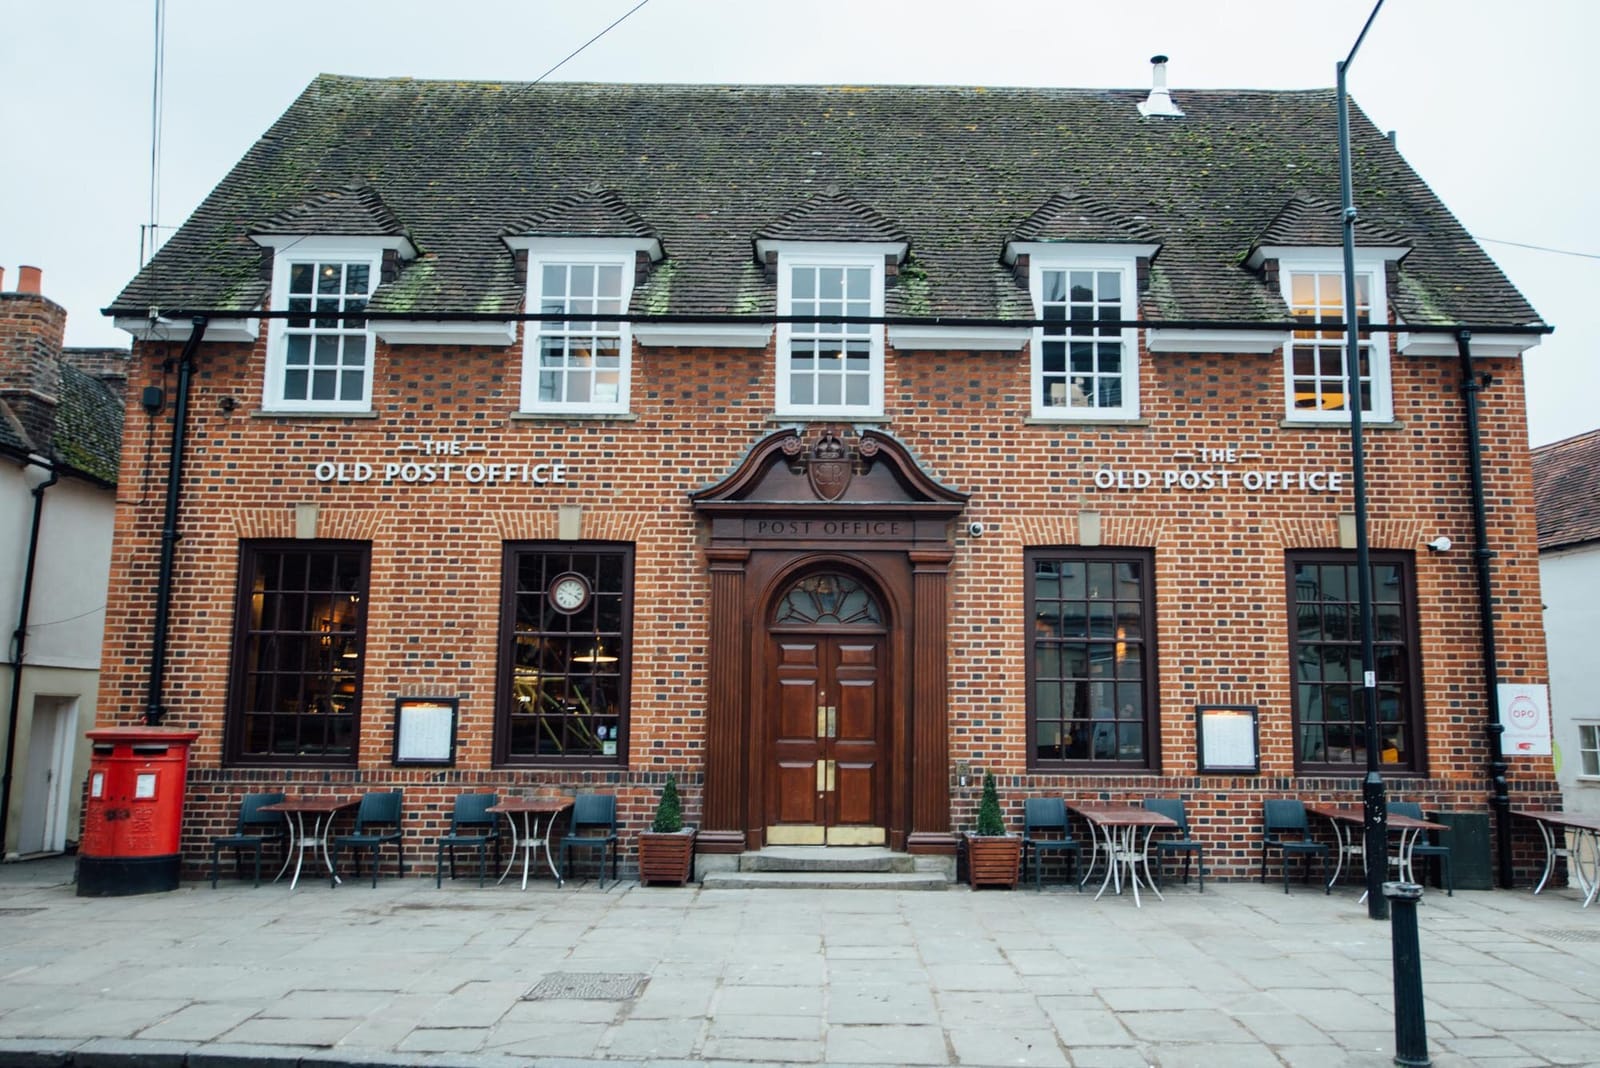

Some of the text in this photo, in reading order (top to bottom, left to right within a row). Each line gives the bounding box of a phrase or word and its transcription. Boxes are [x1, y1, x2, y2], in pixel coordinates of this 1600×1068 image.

[423, 440, 461, 456] THE
[1199, 447, 1238, 464] THE
[315, 461, 568, 485] OLD POST OFFICE
[1094, 468, 1344, 493] OLD POST OFFICE
[758, 520, 900, 535] POST OFFICE
